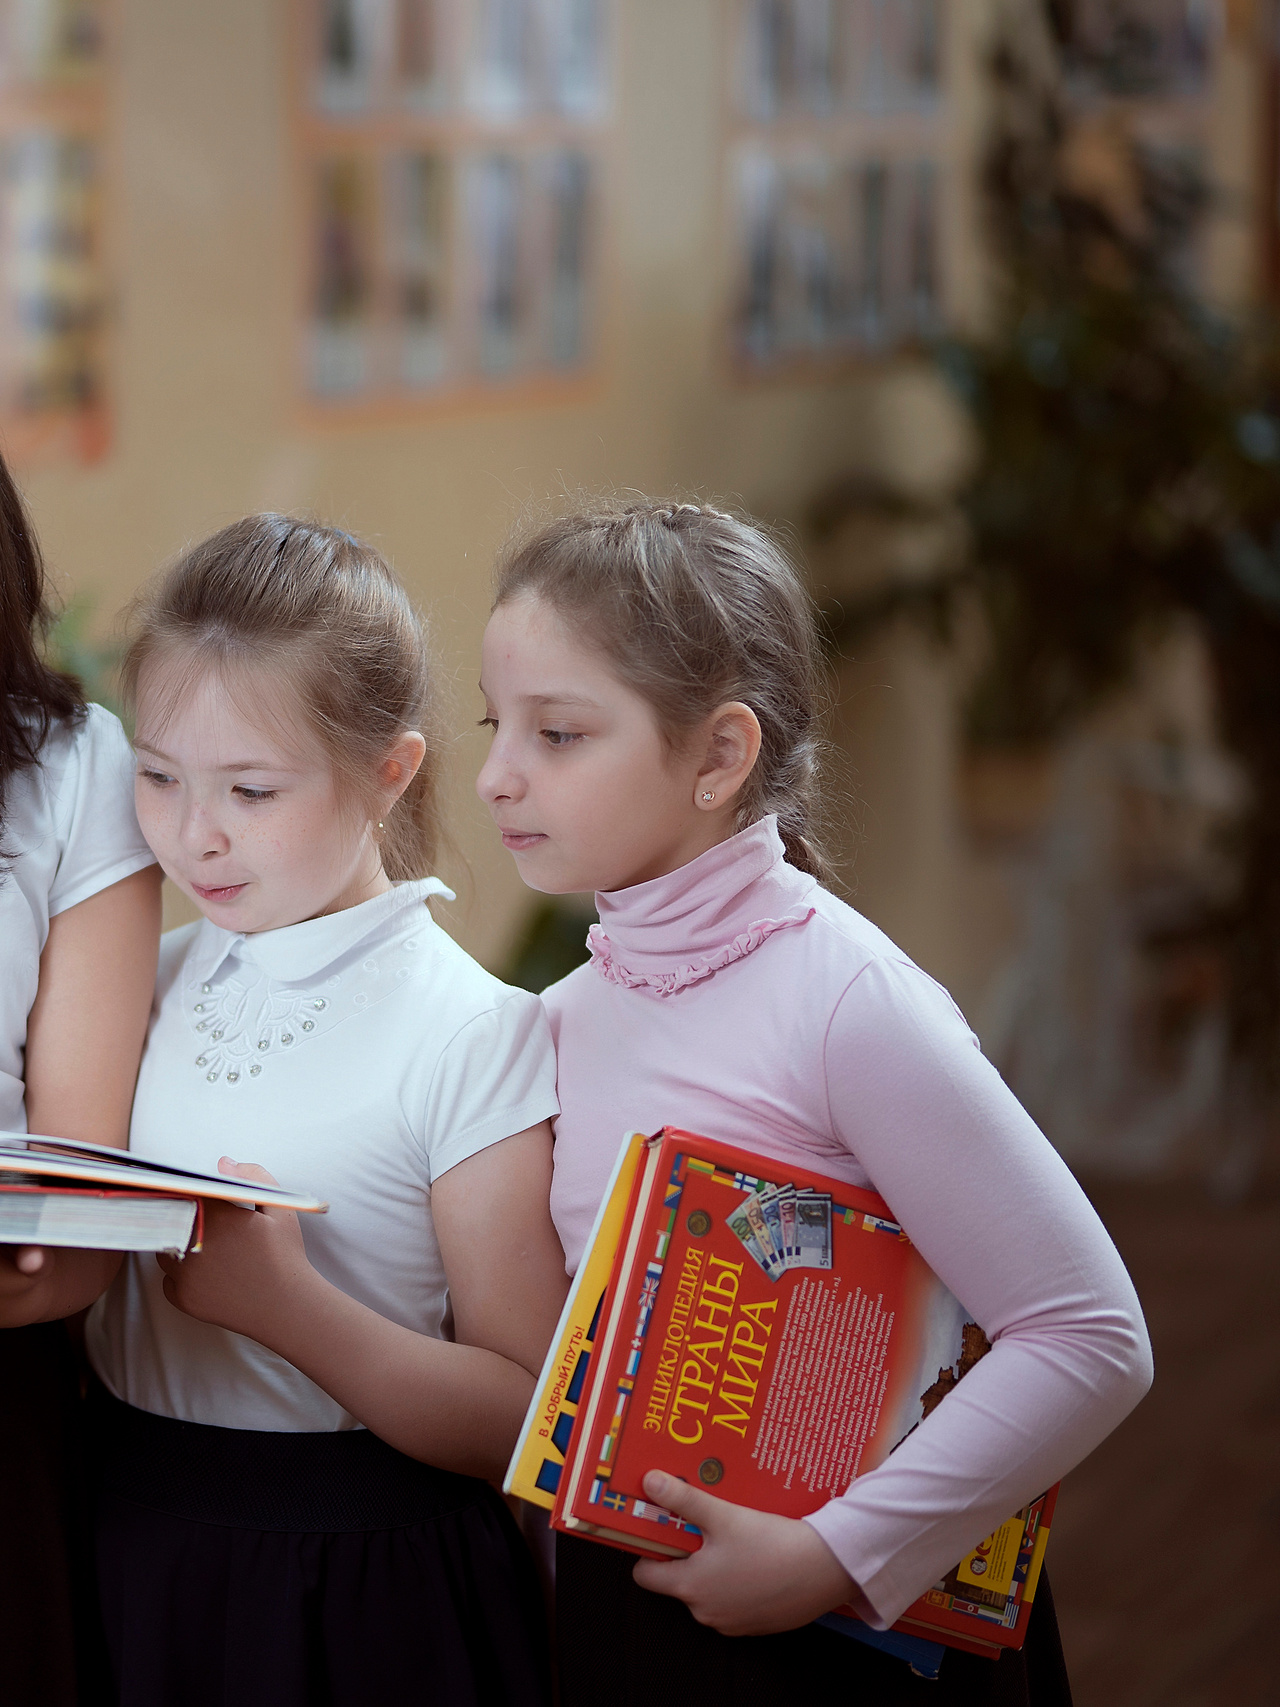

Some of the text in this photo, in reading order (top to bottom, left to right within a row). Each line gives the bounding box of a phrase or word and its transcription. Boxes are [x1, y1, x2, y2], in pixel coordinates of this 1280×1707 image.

[803, 1281, 816, 1312] цветных
[805, 1278, 825, 1331] необходимые
[837, 1290, 853, 1334] выполнены
[868, 1292, 885, 1333] обширный
[797, 1312, 808, 1331] 1000
[852, 1293, 869, 1336] приведены
[859, 1299, 876, 1342] природных
[641, 1244, 706, 1435] ЭНЦИКЛОПЕДИЯ
[663, 1251, 745, 1448] СТРАНЫ
[791, 1331, 803, 1356] более
[803, 1330, 812, 1344] все
[832, 1333, 844, 1357] карты
[844, 1335, 859, 1369] разделе
[854, 1341, 866, 1362] мире
[708, 1288, 780, 1440] МИРА
[756, 1276, 810, 1471] содержащую полную информацию обо всех странах
[769, 1339, 787, 1386] уникальную
[792, 1344, 810, 1389] содержатся
[858, 1404, 875, 1444] указатель
[867, 1371, 881, 1405] поможет
[874, 1343, 890, 1372] быстро
[882, 1310, 896, 1344] отыскать
[536, 1324, 586, 1438] В ДОБРЫЙ ПУТЬ!
[780, 1435, 795, 1472] сведения
[802, 1348, 815, 1374] общая
[810, 1288, 831, 1349] характеристика
[781, 1383, 791, 1398] 200
[806, 1443, 825, 1492] российскими
[846, 1285, 862, 1331] специально
[820, 1357, 839, 1405] выверенные
[834, 1368, 851, 1414] справочном
[844, 1373, 857, 1399] России
[764, 1386, 776, 1409] руках
[776, 1397, 787, 1422] около
[785, 1388, 798, 1417] статьях
[754, 1414, 769, 1447] держите
[814, 1404, 827, 1433] научно
[836, 1405, 851, 1438] крупных
[840, 1447, 857, 1486] глоссарий
[859, 1377, 872, 1412] поясняет
[867, 1345, 882, 1378] научные
[867, 1406, 882, 1437] нужный
[771, 1422, 782, 1444] всего
[830, 1437, 841, 1461] самых
[750, 1446, 760, 1459] Вы
[765, 1448, 776, 1470] мира
[800, 1438, 819, 1483] Подробные
[819, 1453, 830, 1474] этого
[816, 1474, 825, 1490] для
[824, 1461, 836, 1488] списки
